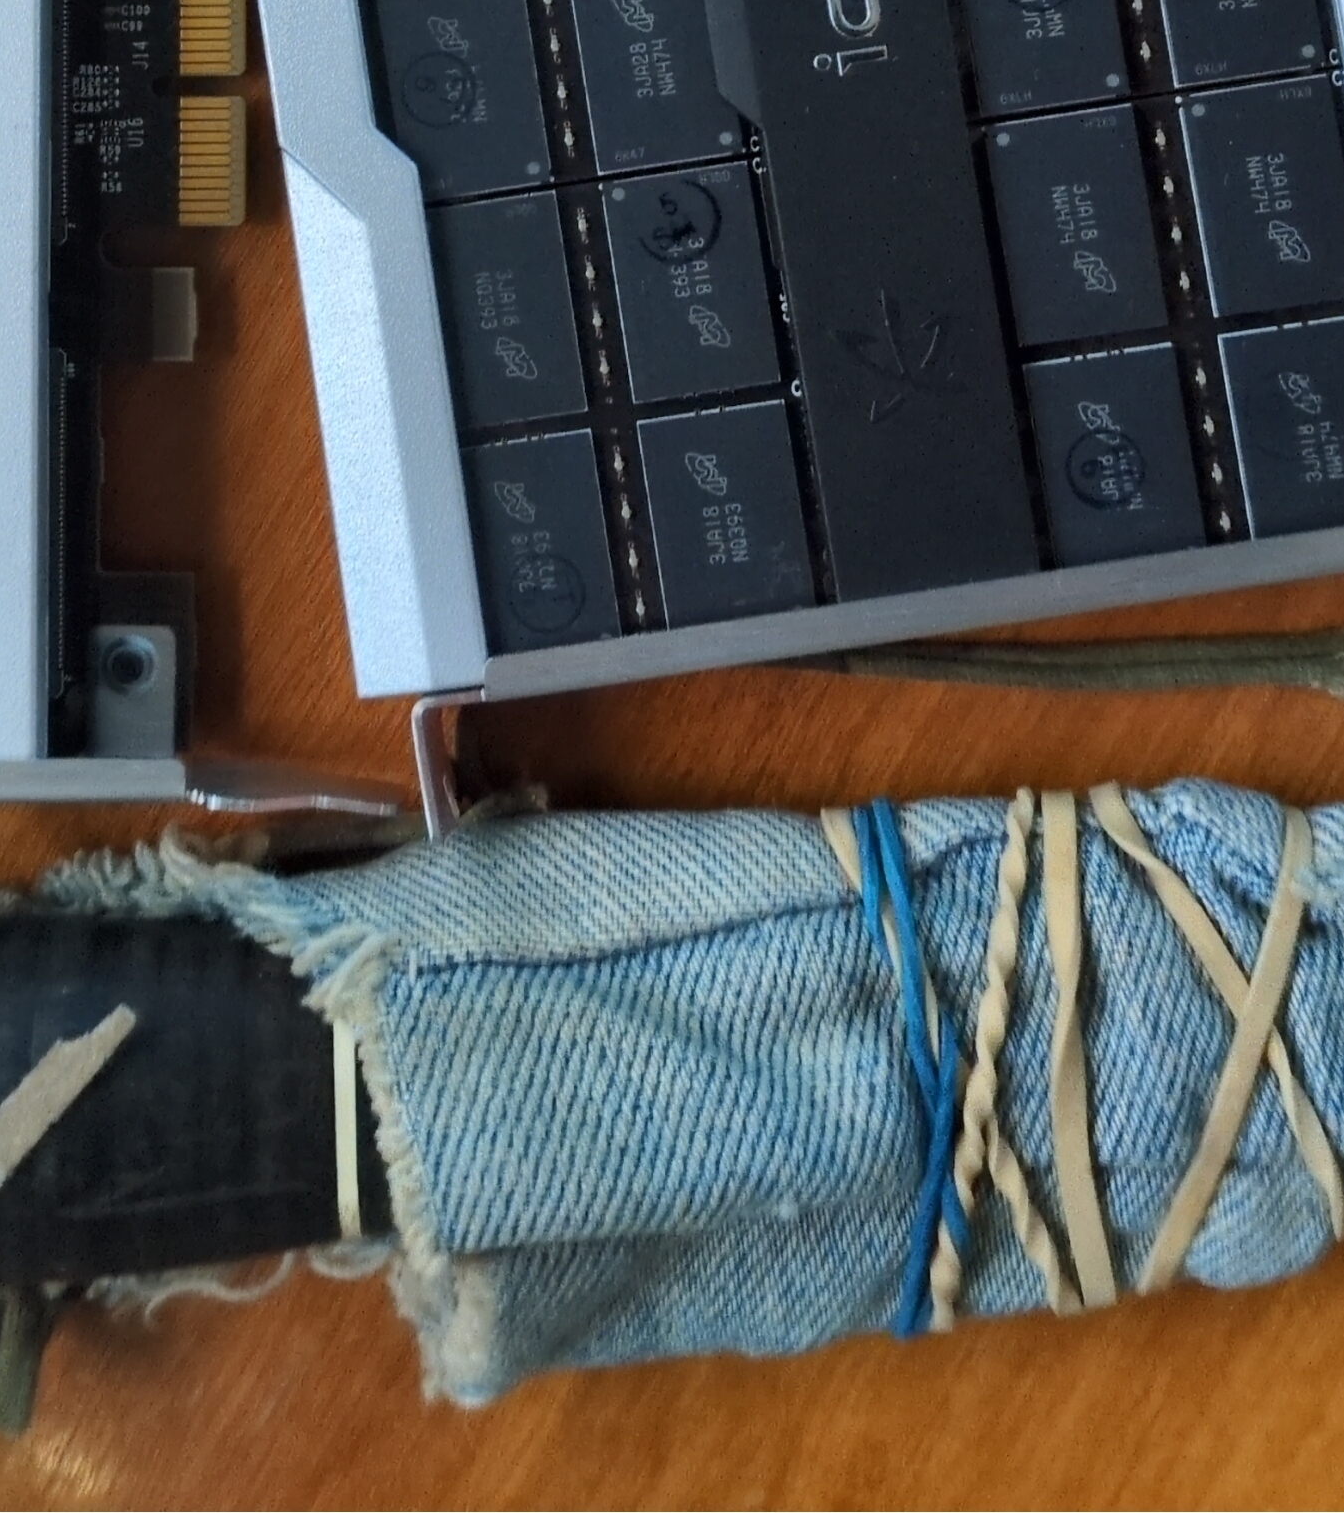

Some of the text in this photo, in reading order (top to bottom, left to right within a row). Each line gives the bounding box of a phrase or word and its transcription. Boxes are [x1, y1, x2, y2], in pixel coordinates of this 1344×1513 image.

[132, 41, 149, 69] J14
[629, 42, 654, 98] 3JA28
[652, 38, 676, 96] NW474
[127, 117, 144, 148] U16
[1245, 156, 1271, 214] NW474
[1267, 153, 1292, 210] 3JA18
[1051, 185, 1075, 245] NW474
[1073, 183, 1098, 241] 3JA18
[474, 272, 497, 330] NQ393
[496, 269, 520, 327] 3JA18
[702, 506, 726, 565] 3JA18
[725, 503, 750, 562] NQ393
